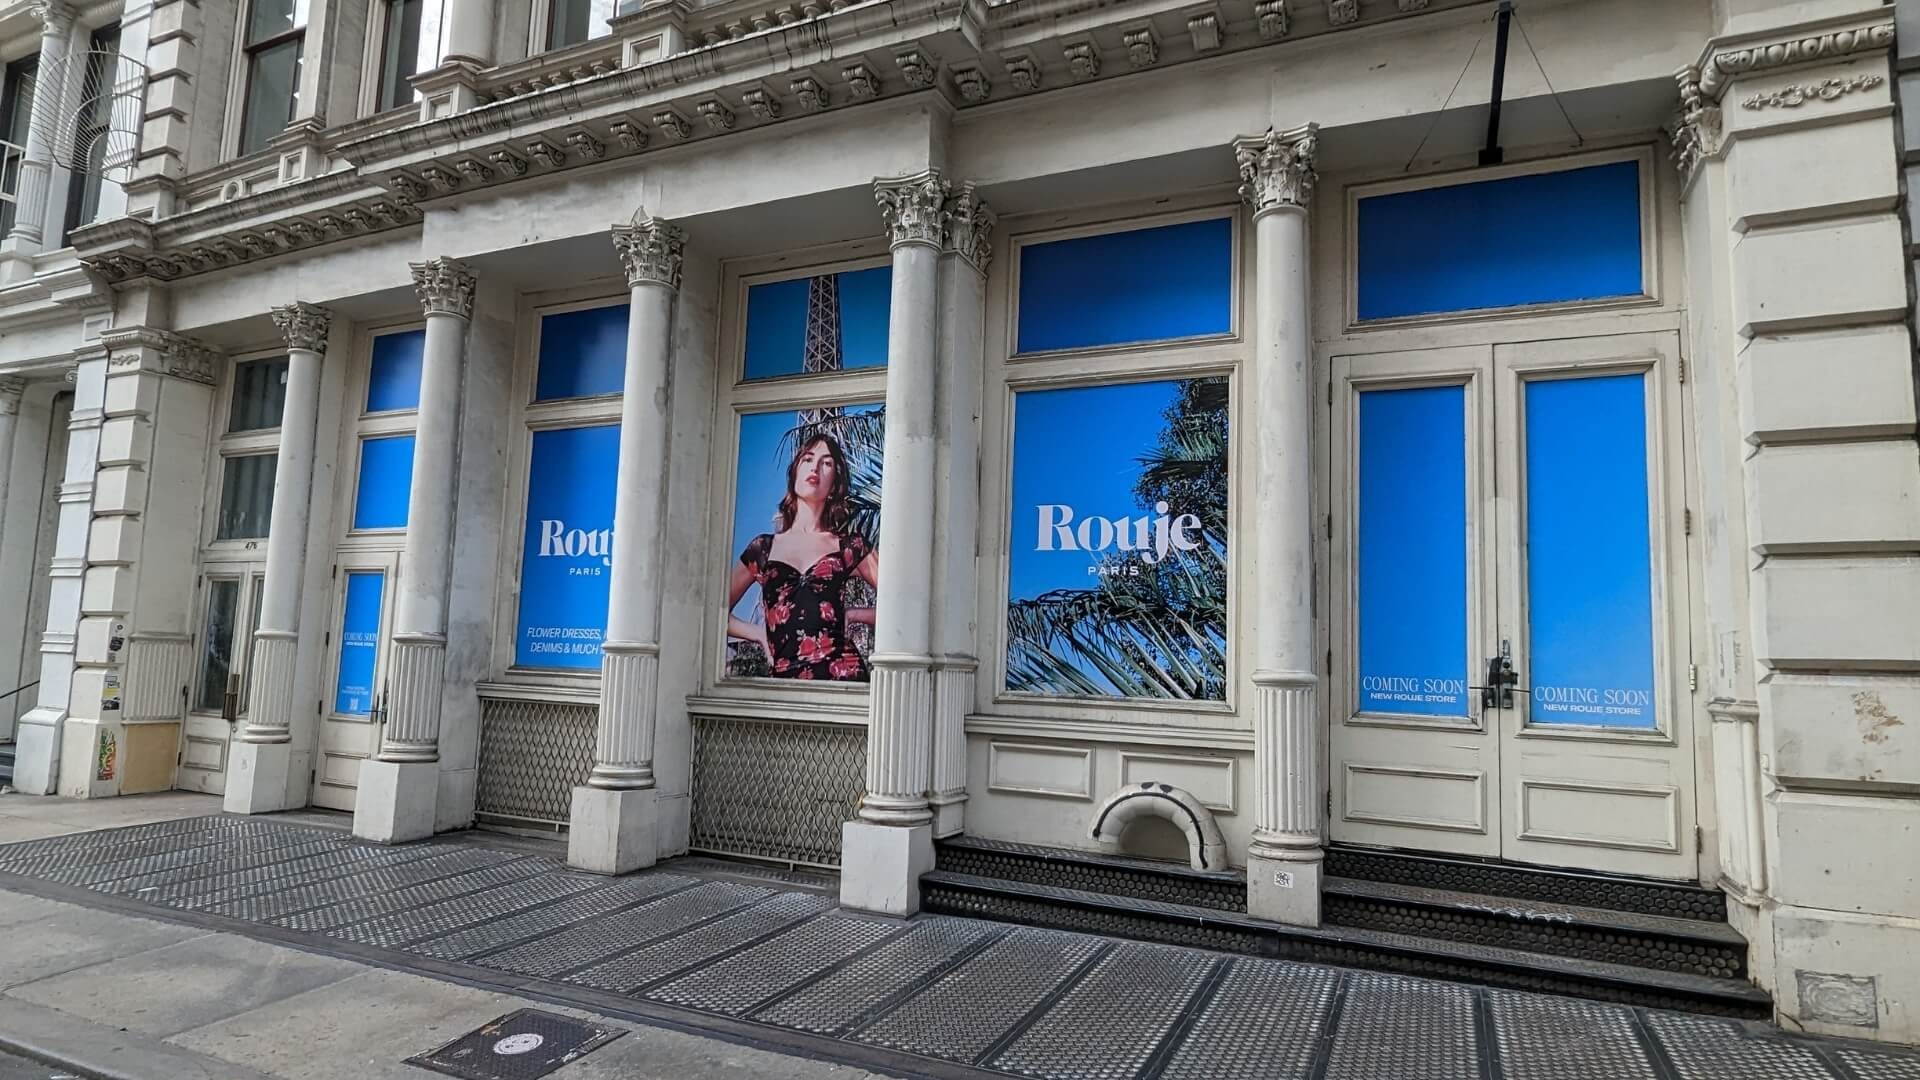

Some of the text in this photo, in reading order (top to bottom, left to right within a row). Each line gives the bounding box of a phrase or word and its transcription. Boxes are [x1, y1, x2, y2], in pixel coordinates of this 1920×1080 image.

[1034, 501, 1202, 564] Rouje
[569, 567, 601, 576] PARIS
[1088, 566, 1140, 577] PARIS
[527, 626, 562, 638] FLOWER
[530, 642, 563, 653] DENIMS
[563, 642, 571, 653] &
[571, 643, 599, 655] MUCH
[1363, 676, 1464, 695] COMING SOON
[1370, 692, 1393, 700] NEW
[1425, 695, 1457, 703] STORE
[1535, 686, 1649, 706] COMING SOON
[1544, 703, 1568, 711] NEW
[1606, 706, 1641, 715] STORE
